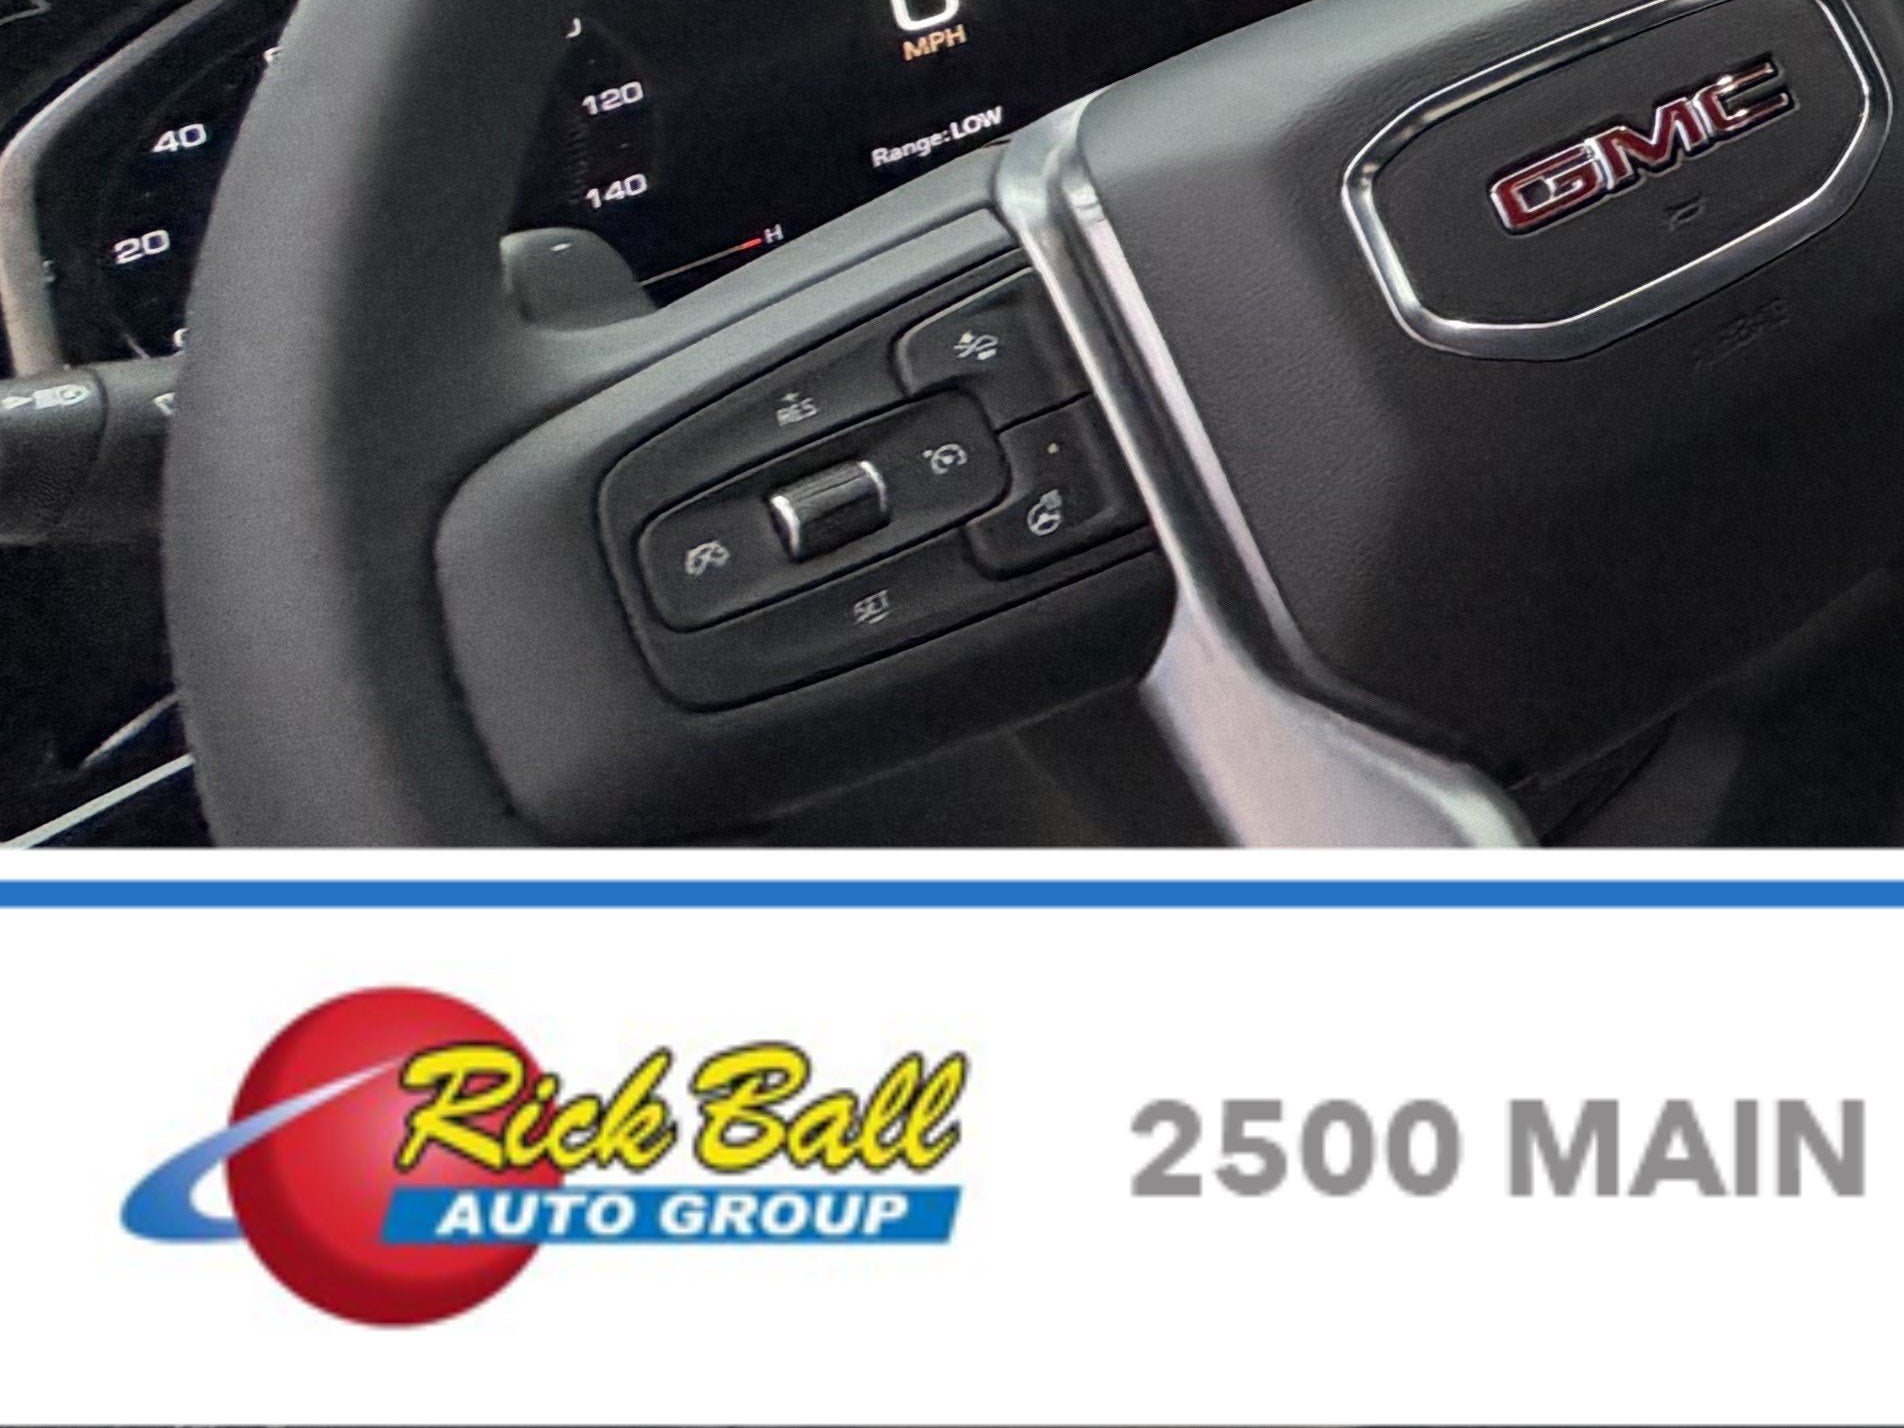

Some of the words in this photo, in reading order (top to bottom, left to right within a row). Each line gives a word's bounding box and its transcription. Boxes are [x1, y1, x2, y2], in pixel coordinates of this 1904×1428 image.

[902, 24, 967, 61] MPH
[582, 81, 643, 115] 120
[152, 123, 207, 153] 40
[870, 130, 950, 167] Range:
[950, 105, 1003, 140] LOW
[1490, 62, 1790, 230] GMC
[587, 174, 647, 209] 140
[113, 229, 170, 264] 20
[764, 224, 784, 244] H
